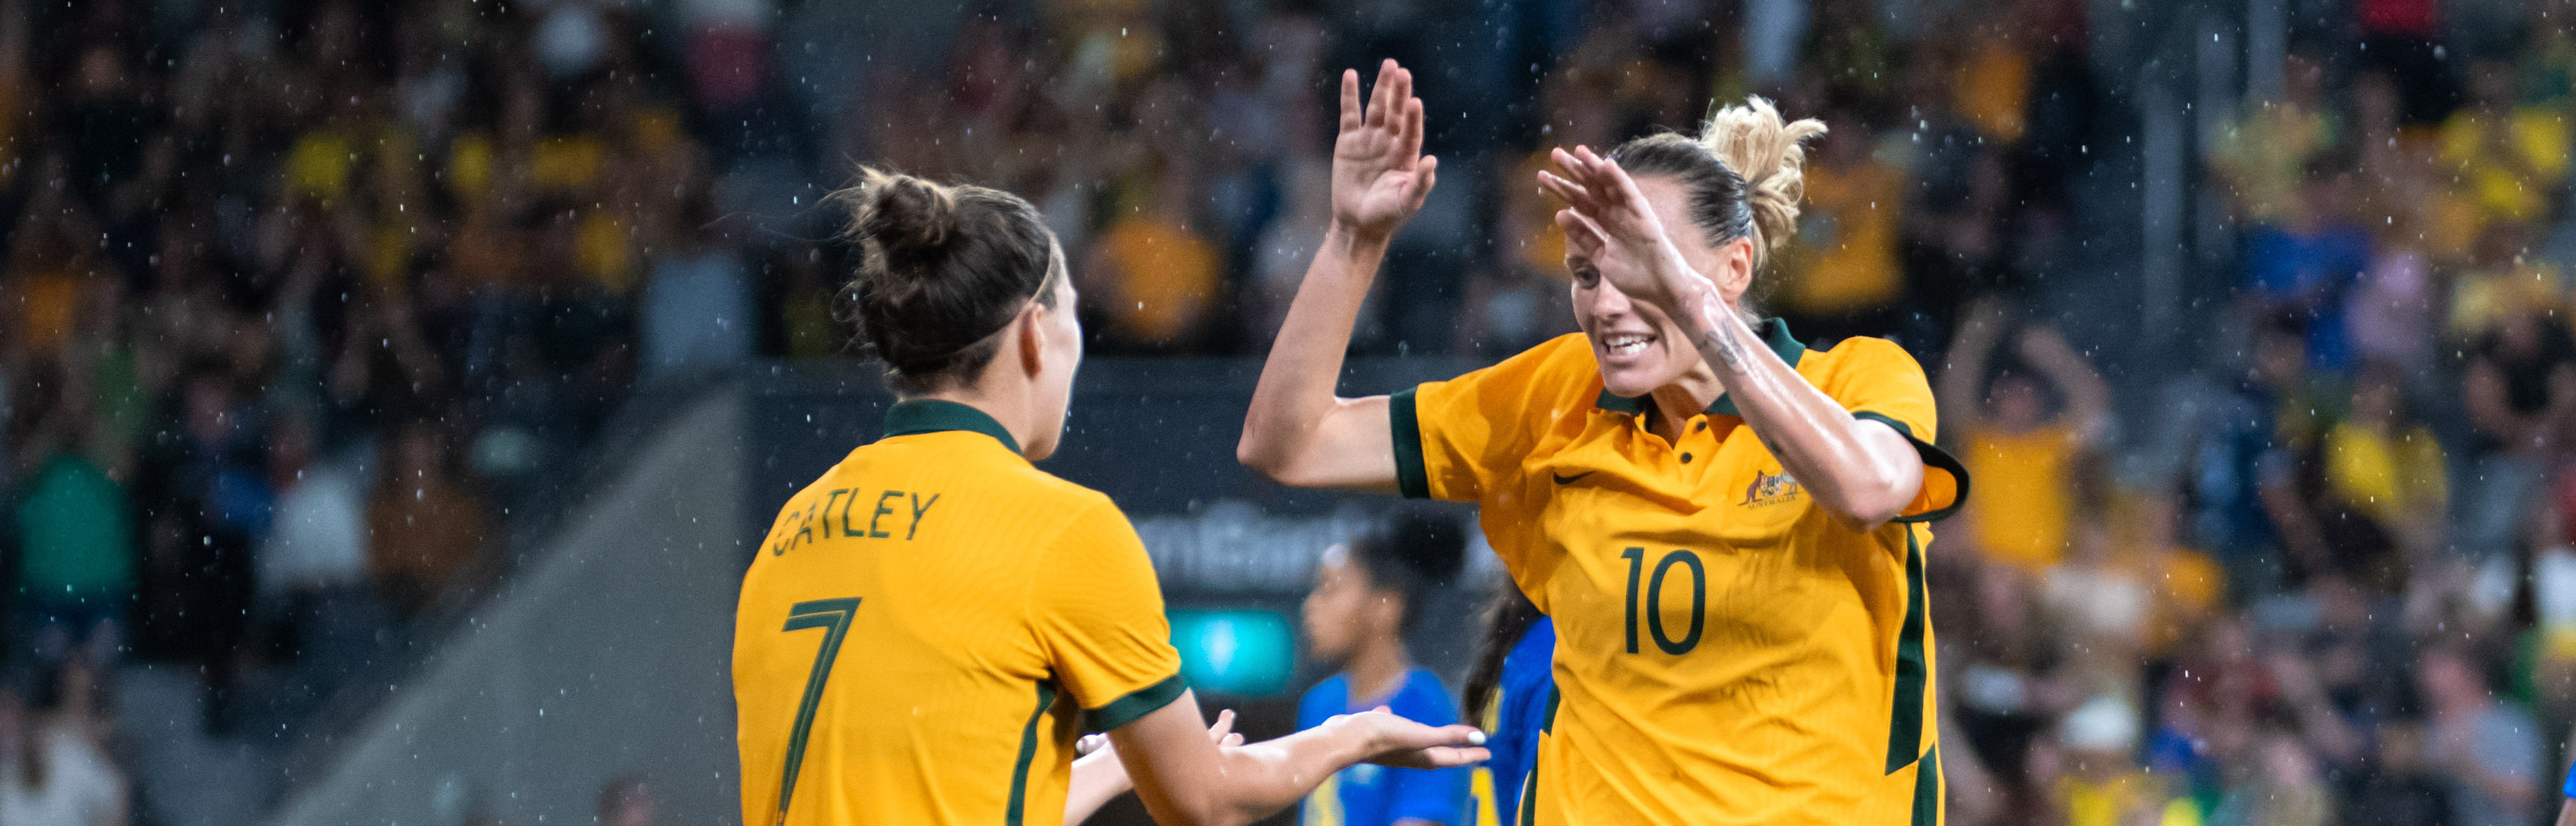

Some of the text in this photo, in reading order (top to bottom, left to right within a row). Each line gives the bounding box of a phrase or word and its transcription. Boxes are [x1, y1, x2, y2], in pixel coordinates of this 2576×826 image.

[773, 487, 941, 556] CATLEY
[1748, 495, 1796, 509] AUSTRALIA
[1620, 547, 1706, 655] 10
[782, 597, 863, 826] 7
